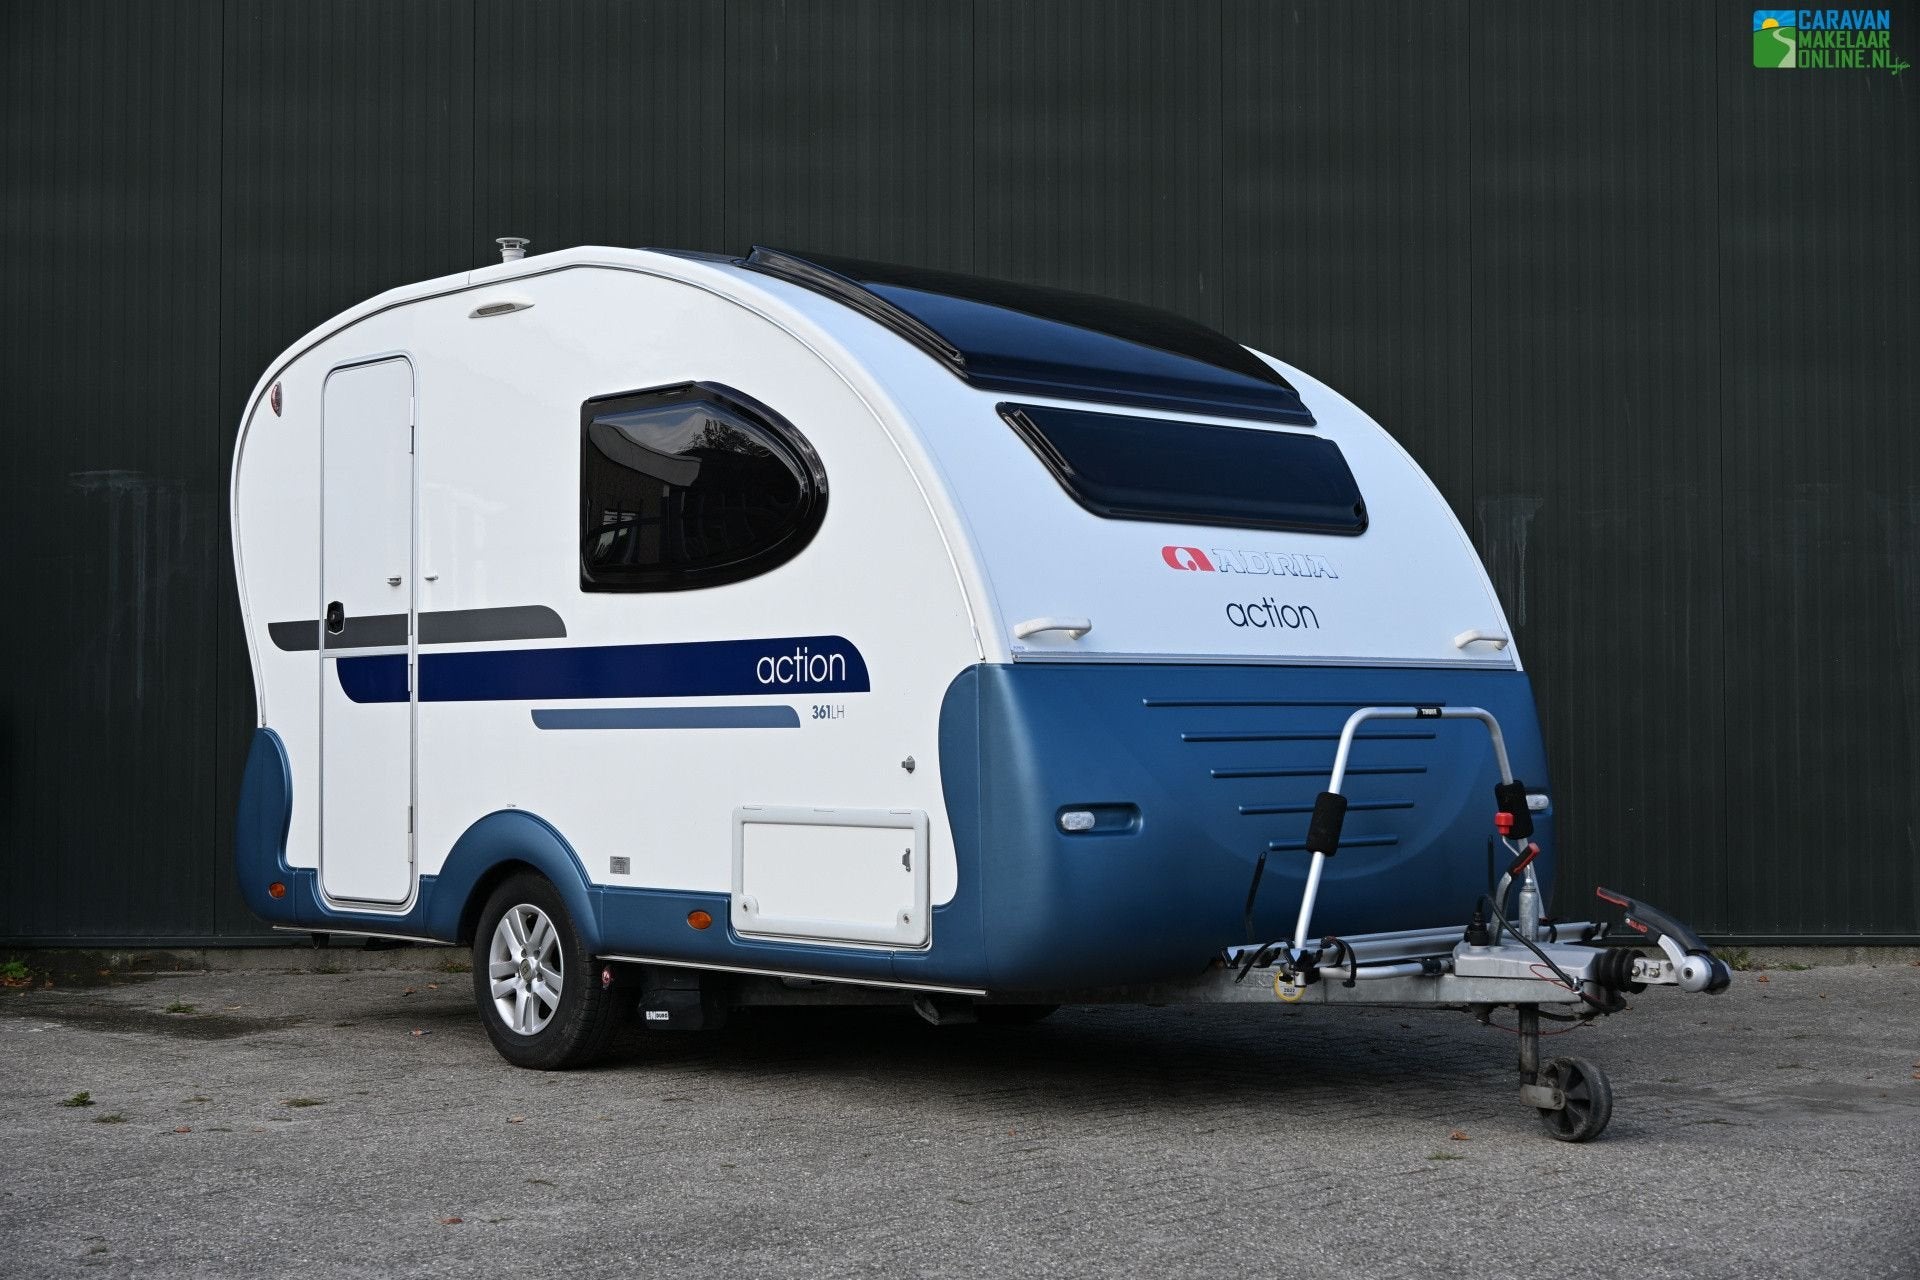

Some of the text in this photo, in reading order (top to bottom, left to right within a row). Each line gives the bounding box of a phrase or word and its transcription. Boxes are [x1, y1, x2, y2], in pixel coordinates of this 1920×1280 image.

[1211, 549, 1339, 579] ADRIA
[1226, 597, 1320, 629] action
[757, 646, 846, 684] action
[812, 705, 845, 719] 361LH
